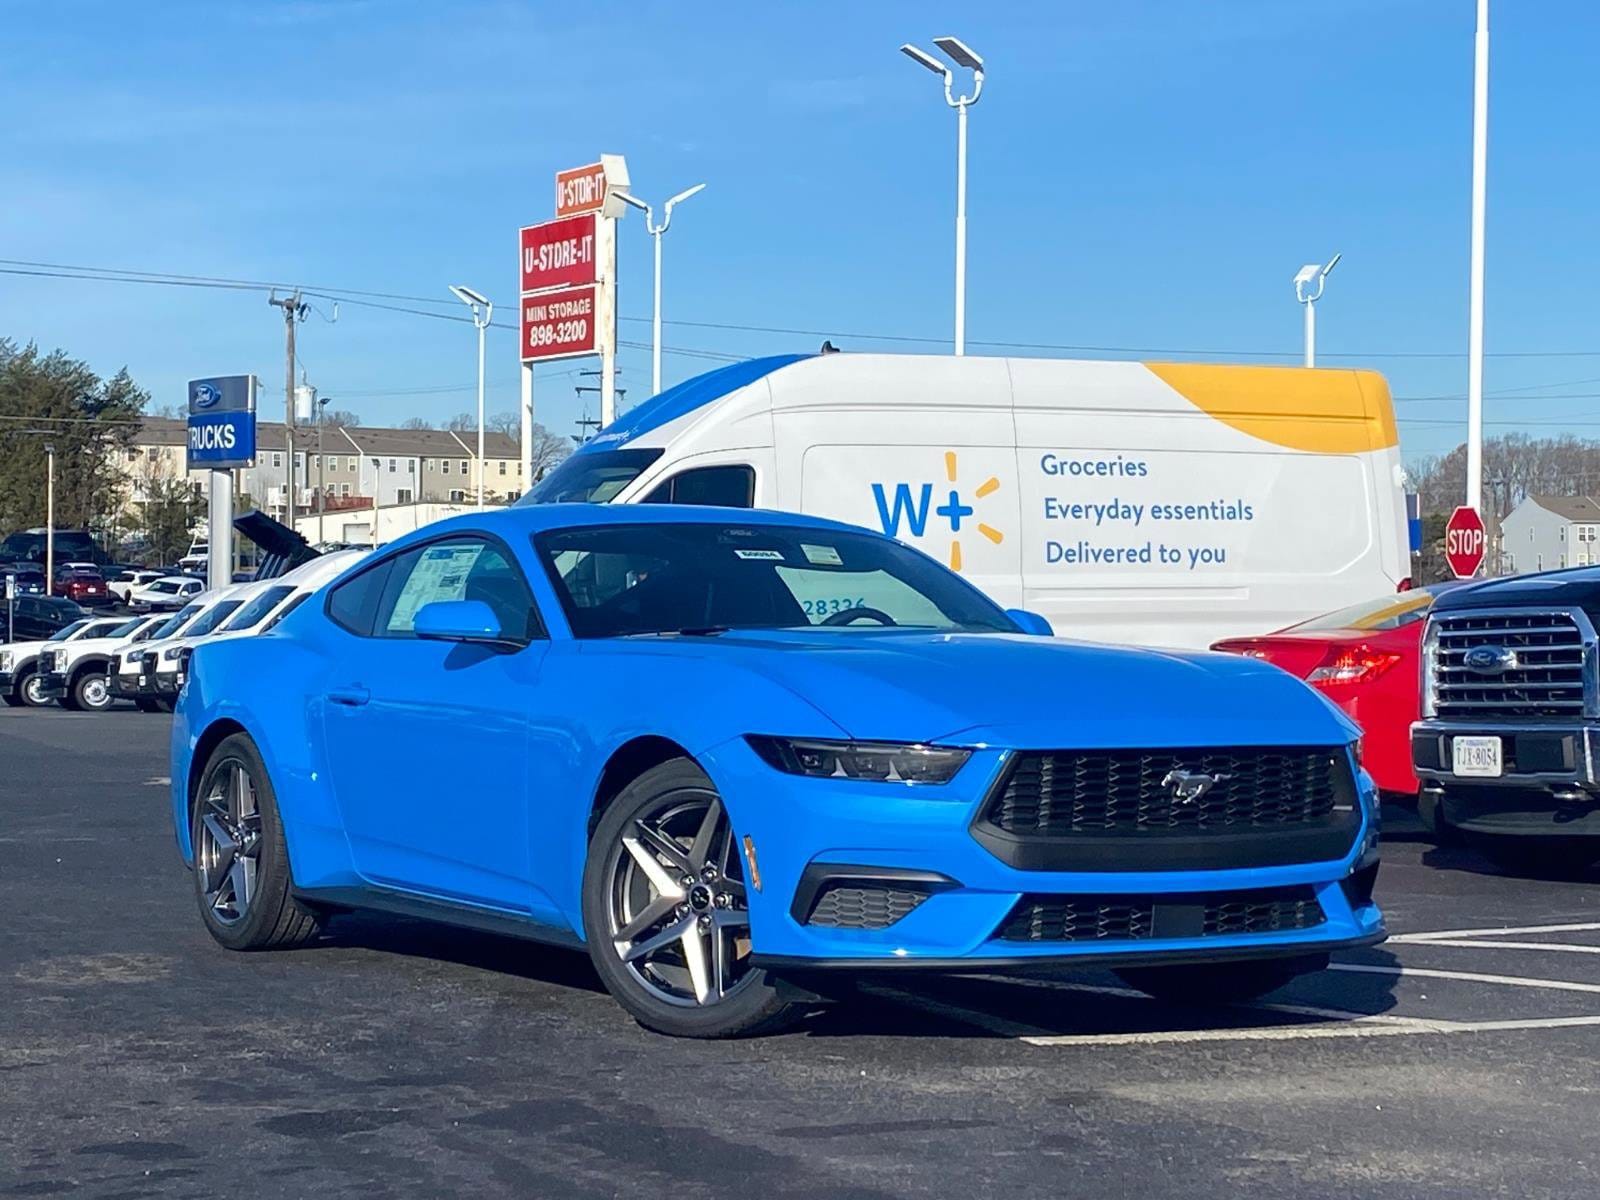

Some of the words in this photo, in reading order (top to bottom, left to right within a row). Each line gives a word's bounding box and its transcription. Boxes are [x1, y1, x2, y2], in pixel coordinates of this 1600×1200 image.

[558, 172, 604, 209] U-STOR-IT
[525, 235, 593, 274] U-STORE-IT
[526, 304, 547, 322] MINI
[549, 298, 592, 319] STORAGE
[530, 319, 587, 347] 898-3200
[1040, 454, 1148, 477] Groceries
[1044, 497, 1144, 526] Everyday
[1151, 499, 1254, 521] essentials
[1046, 541, 1152, 564] Delivered
[1158, 544, 1182, 563] to
[1188, 547, 1226, 570] you
[1449, 529, 1482, 555] STOP
